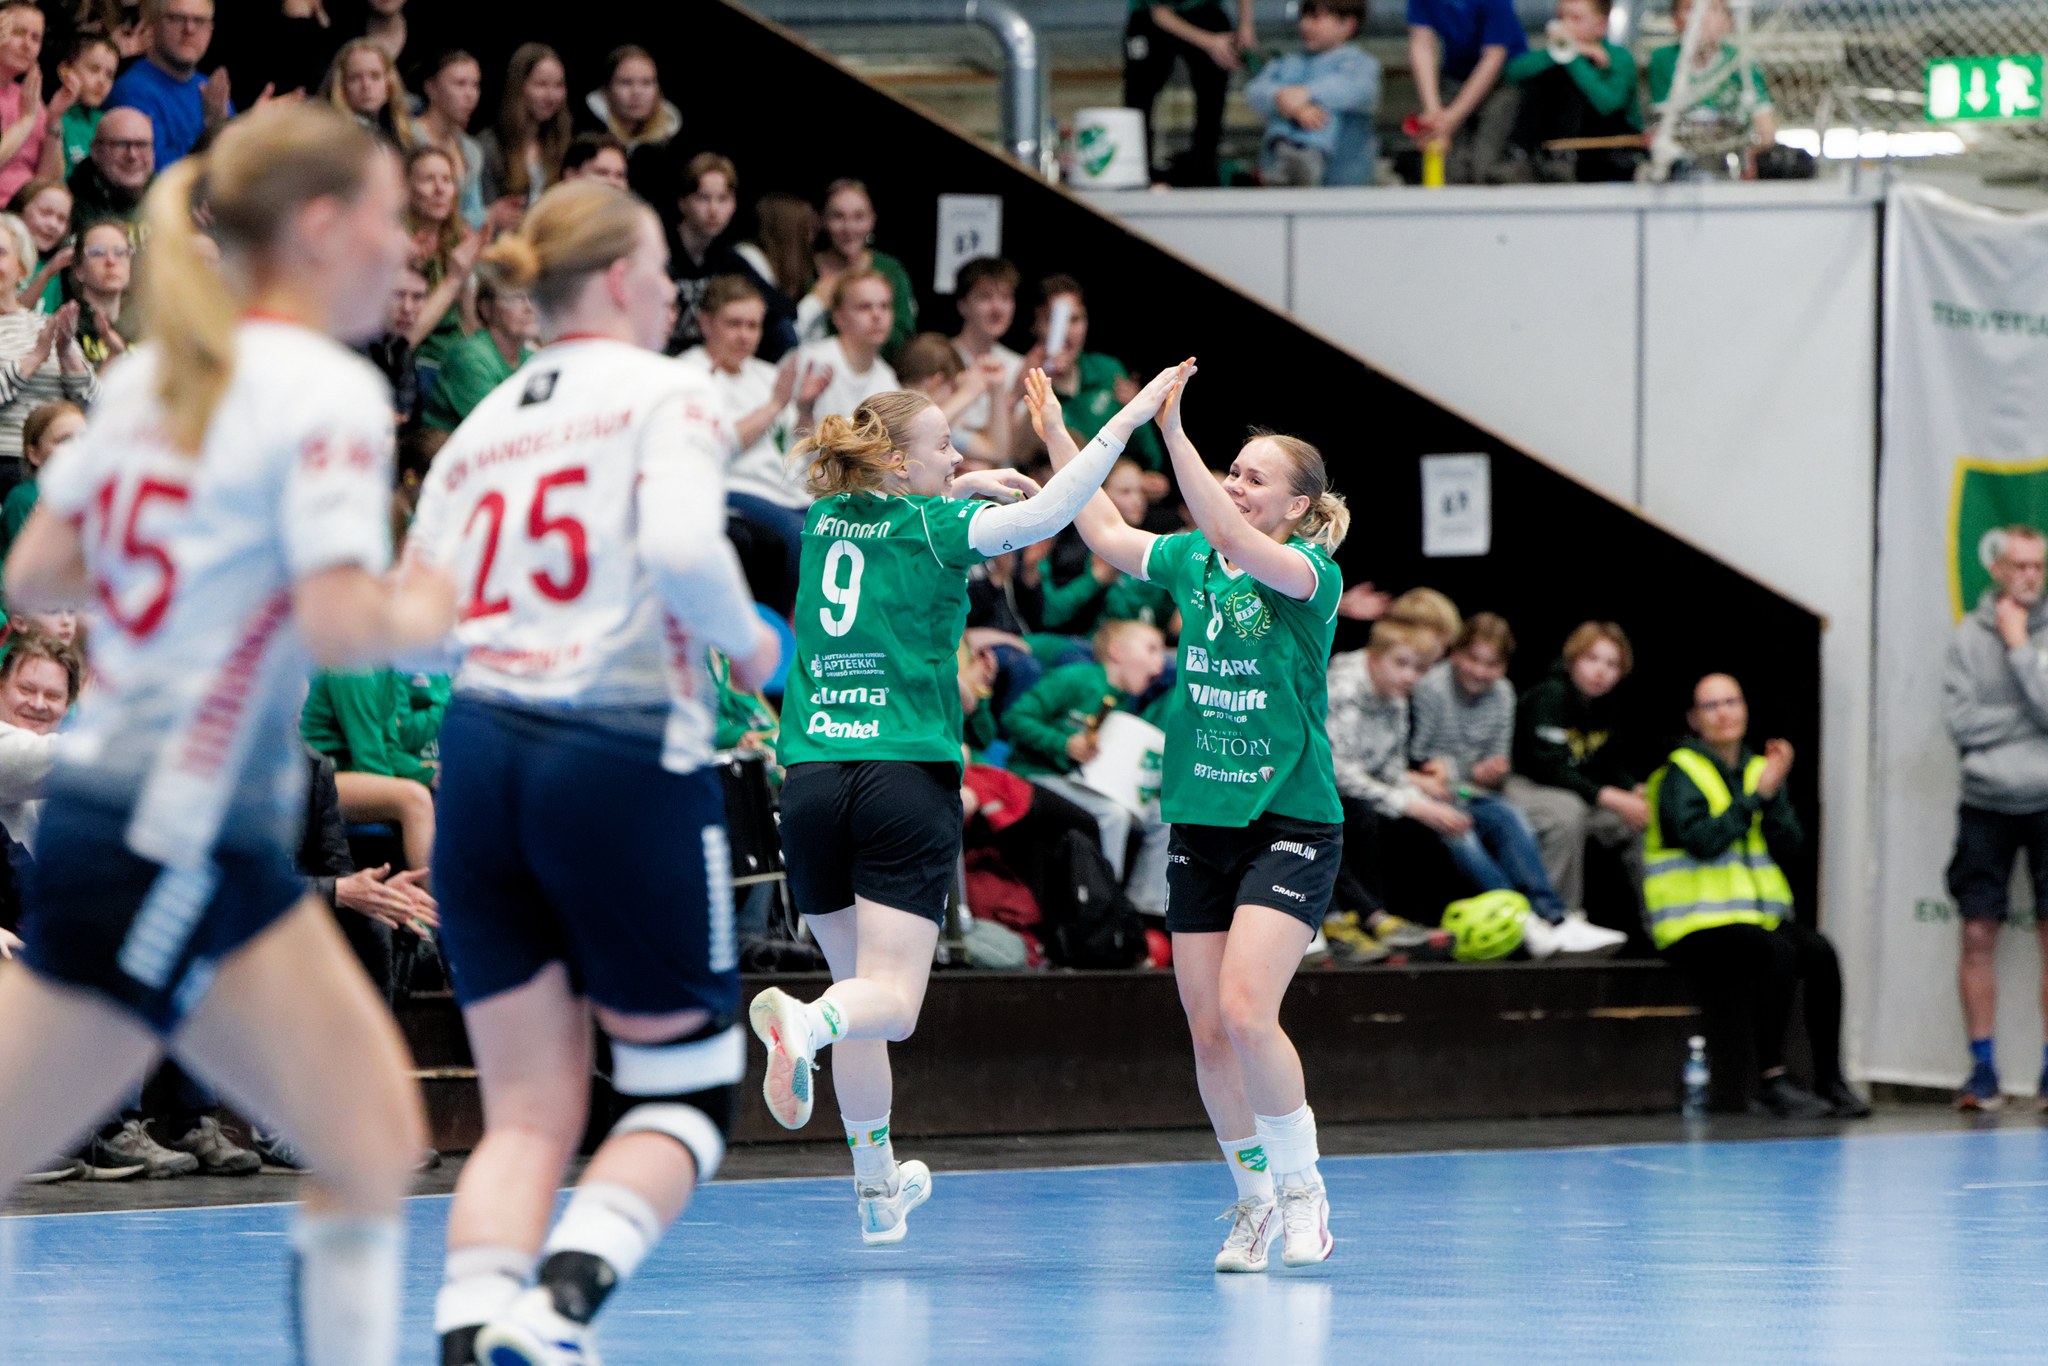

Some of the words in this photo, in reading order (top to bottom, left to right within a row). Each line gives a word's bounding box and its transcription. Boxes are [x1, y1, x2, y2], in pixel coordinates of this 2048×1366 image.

[458, 466, 590, 625] 25
[819, 539, 865, 638] 9
[824, 659, 877, 672] APTEEKKI
[806, 711, 880, 739] Pentel
[1203, 710, 1216, 718] UP
[1216, 711, 1224, 719] TO
[1196, 728, 1271, 756] FACTORY
[1272, 884, 1301, 900] CRAFT
